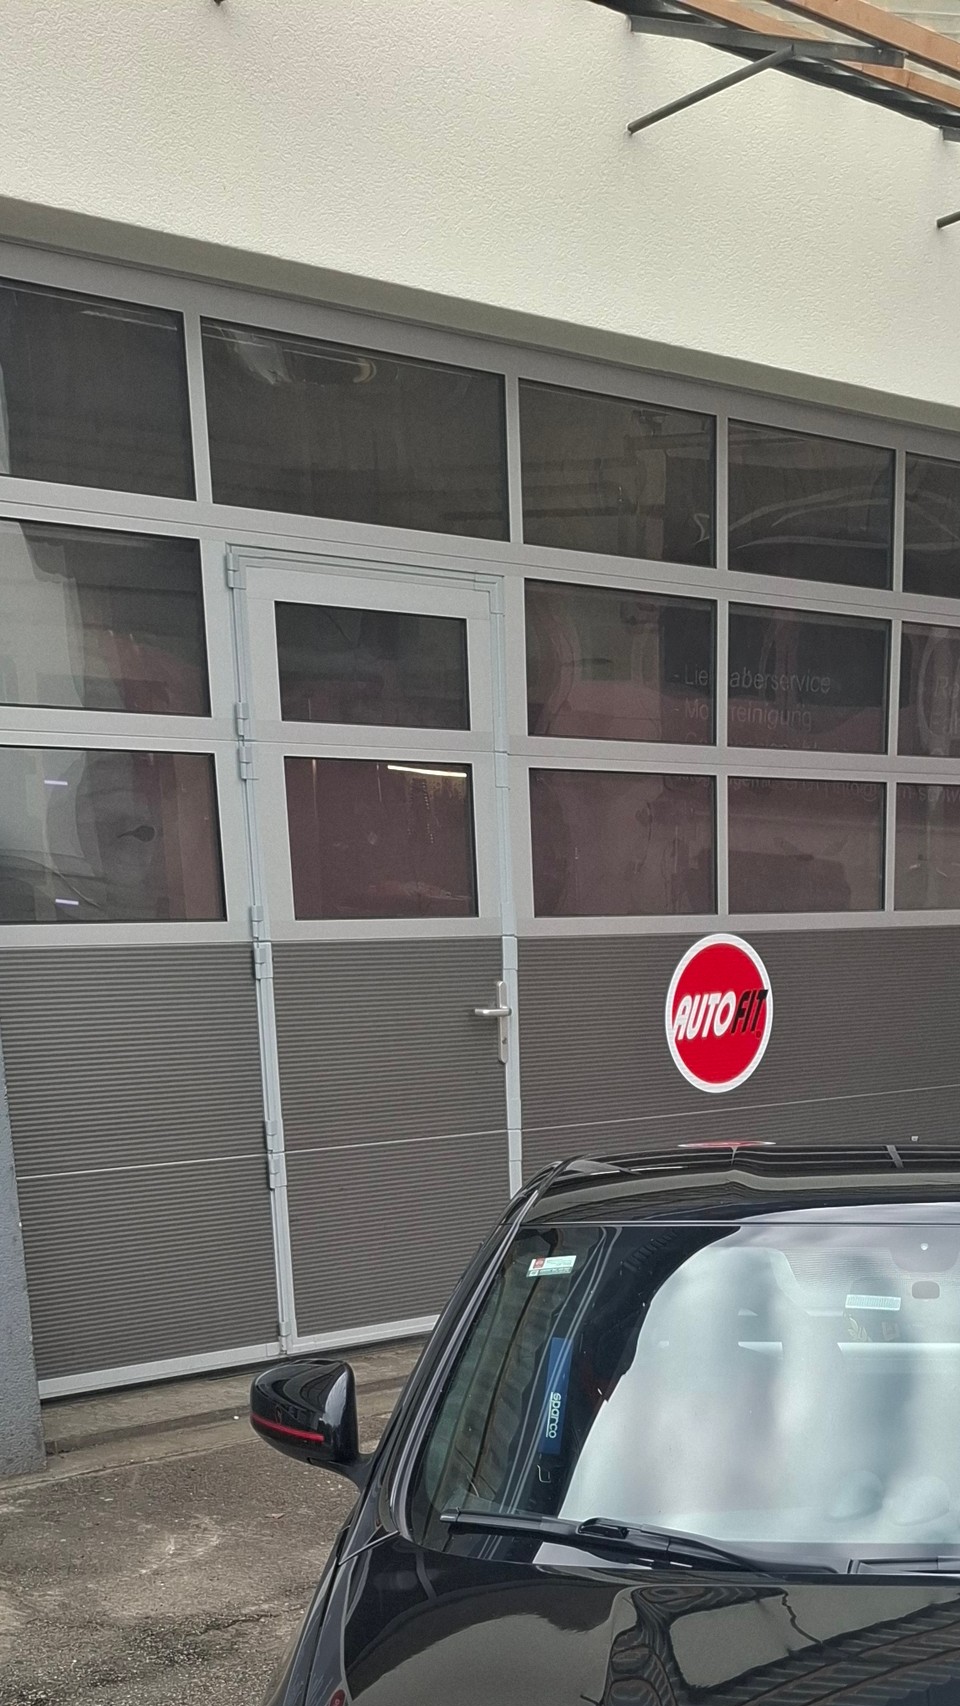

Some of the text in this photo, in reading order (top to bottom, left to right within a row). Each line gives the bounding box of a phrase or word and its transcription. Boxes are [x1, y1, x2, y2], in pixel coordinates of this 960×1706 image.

[685, 664, 831, 694] Lieaberservice
[685, 699, 812, 732] Moreinigung
[548, 1392, 562, 1439] sparco
